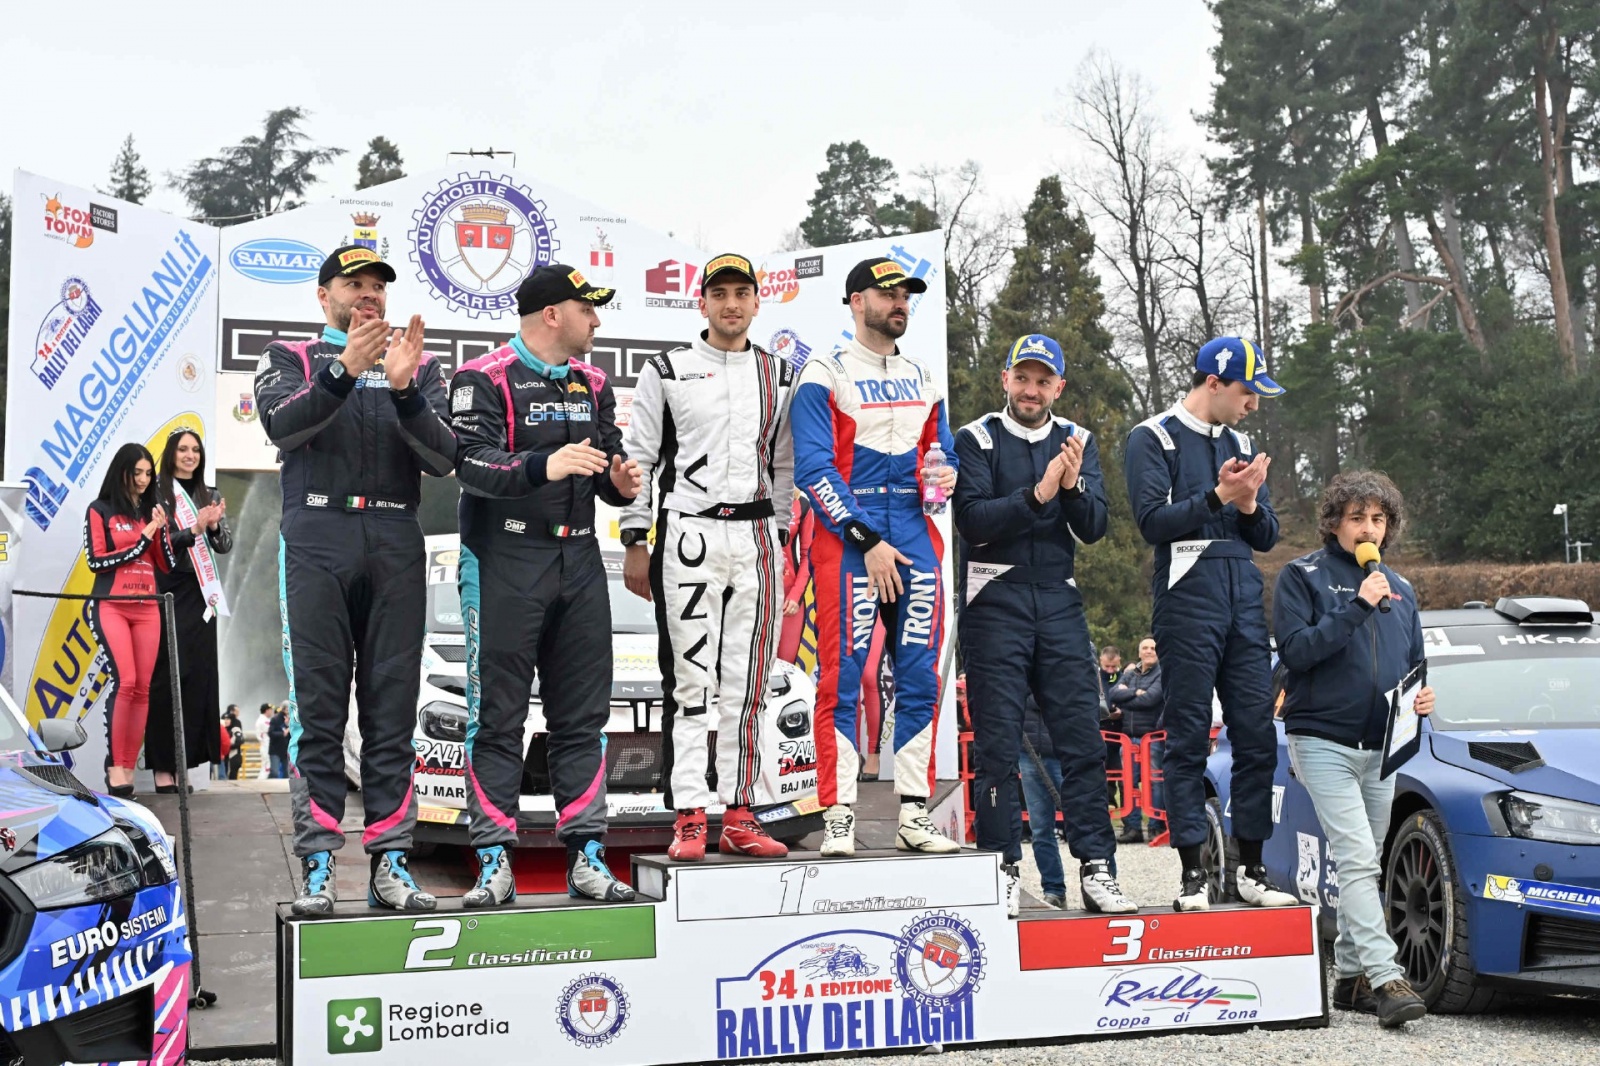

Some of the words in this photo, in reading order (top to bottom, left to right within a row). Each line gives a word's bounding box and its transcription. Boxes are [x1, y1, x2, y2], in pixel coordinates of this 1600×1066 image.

[339, 198, 380, 207] patrocinio
[63, 206, 93, 227] FOX
[92, 207, 115, 220] FACTORY
[92, 216, 115, 228] STORES
[419, 182, 507, 254] AUTOMOBILE
[528, 211, 549, 262] CLUB
[579, 215, 614, 224] patrocinio
[44, 216, 93, 239] TOWN
[797, 266, 821, 276] STORES
[798, 258, 821, 269] FACTORY
[768, 267, 799, 283] FOX
[759, 281, 799, 298] OWN
[646, 299, 669, 308] EDIL
[670, 300, 691, 309] ART
[38, 342, 53, 360] 34
[38, 347, 69, 391] RALLY
[60, 322, 82, 358] DEI
[40, 228, 202, 471] MAGUGLIANI.it
[794, 339, 812, 374] AGHI
[76, 378, 134, 464] COMPONENTI
[132, 351, 151, 376] PER
[150, 275, 201, 349] L'INDUSTRIA
[854, 378, 921, 402] TRONY
[78, 452, 103, 489] Busto
[101, 407, 130, 451] Arsizio
[306, 495, 329, 506] OMP
[812, 476, 852, 523] TRONY
[504, 520, 527, 532] OMP
[1176, 543, 1206, 553] sparco
[972, 566, 998, 575] sparco
[902, 569, 935, 646] TRONY
[1498, 634, 1555, 645] HK
[1556, 636, 1600, 644] RA
[779, 740, 815, 763] RALL
[414, 756, 465, 777] Dreame
[414, 784, 428, 795] AJ
[433, 785, 465, 798] MAR
[780, 782, 799, 794] BAJ
[798, 800, 820, 813] PIRE
[812, 896, 927, 914] Classificato
[1527, 886, 1600, 905] MICHELIN
[50, 921, 119, 968] EURO
[119, 905, 166, 941] SISTEMI
[466, 948, 592, 967] Classificato
[899, 917, 966, 958] AUTOMOBILE
[968, 947, 980, 986] CLUB
[1147, 944, 1252, 961] Classificato
[759, 969, 798, 1001] 34
[804, 983, 815, 998] A
[820, 979, 893, 997] EDIZIONE
[904, 981, 951, 1007] VARESE
[1104, 973, 1223, 1010] Rally
[561, 978, 604, 1019] AUTOMOBILE
[613, 988, 626, 1015] CLUB
[389, 1002, 483, 1023] Regione
[1096, 1015, 1151, 1030] Coppa
[1173, 1010, 1190, 1024] di
[1217, 1007, 1258, 1021] Zona
[389, 1018, 510, 1042] Lombardia
[716, 1003, 812, 1059] RALLY
[823, 999, 876, 1051] DEI
[884, 992, 974, 1047] LAGHI
[575, 1030, 613, 1044] VARESE
